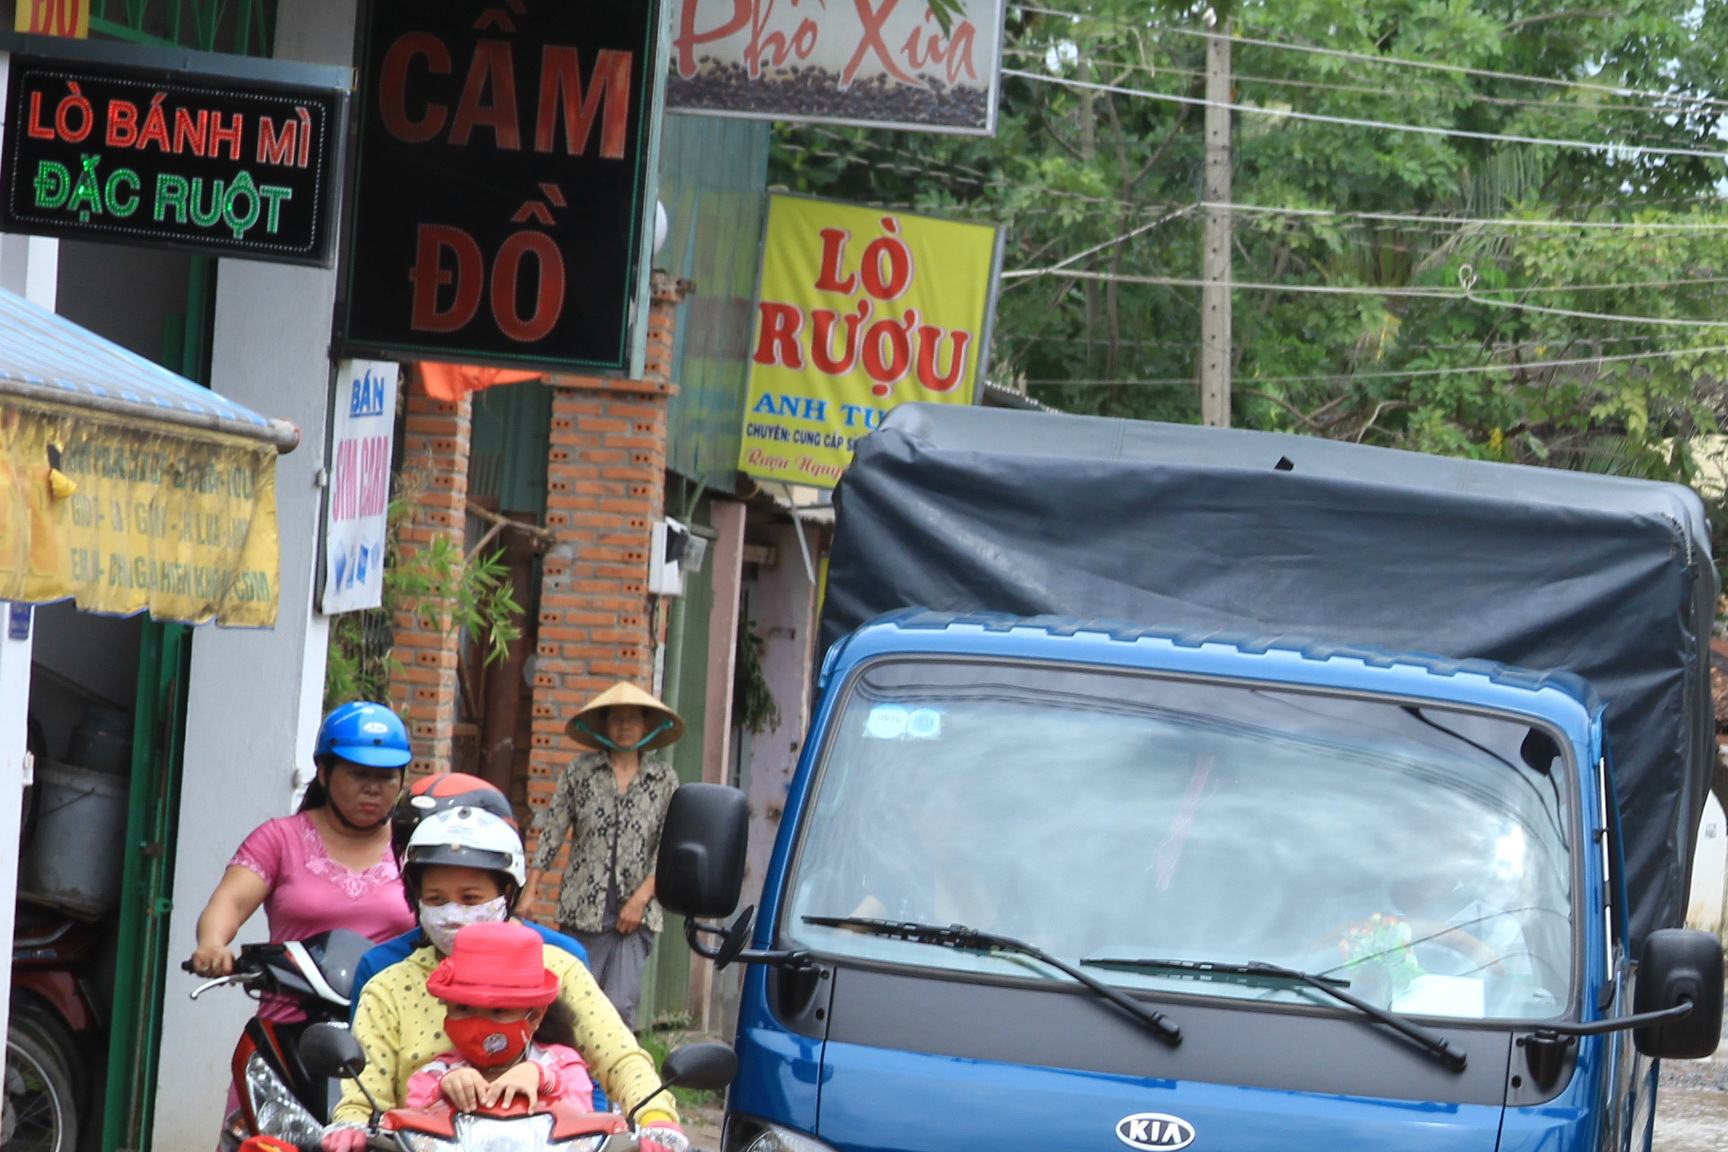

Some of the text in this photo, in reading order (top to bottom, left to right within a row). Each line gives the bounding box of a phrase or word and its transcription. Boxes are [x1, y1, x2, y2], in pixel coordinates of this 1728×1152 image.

[379, 0, 633, 160] CẦM
[28, 81, 312, 168] LÒ BÁNH MÌ
[34, 154, 292, 240] ĐẶC RUỘT
[409, 183, 567, 343] ĐỒ
[814, 216, 912, 300] LÒ
[753, 299, 971, 397] RƯỢU
[350, 369, 385, 415] BÁN
[752, 392, 829, 422] ANH
[746, 422, 790, 442] CHUYÊN:
[793, 432, 821, 447] CUNG
[823, 428, 844, 449] CẤP
[332, 438, 358, 523] SIM
[358, 435, 389, 519] CARD
[1129, 1119, 1183, 1144] KIA
